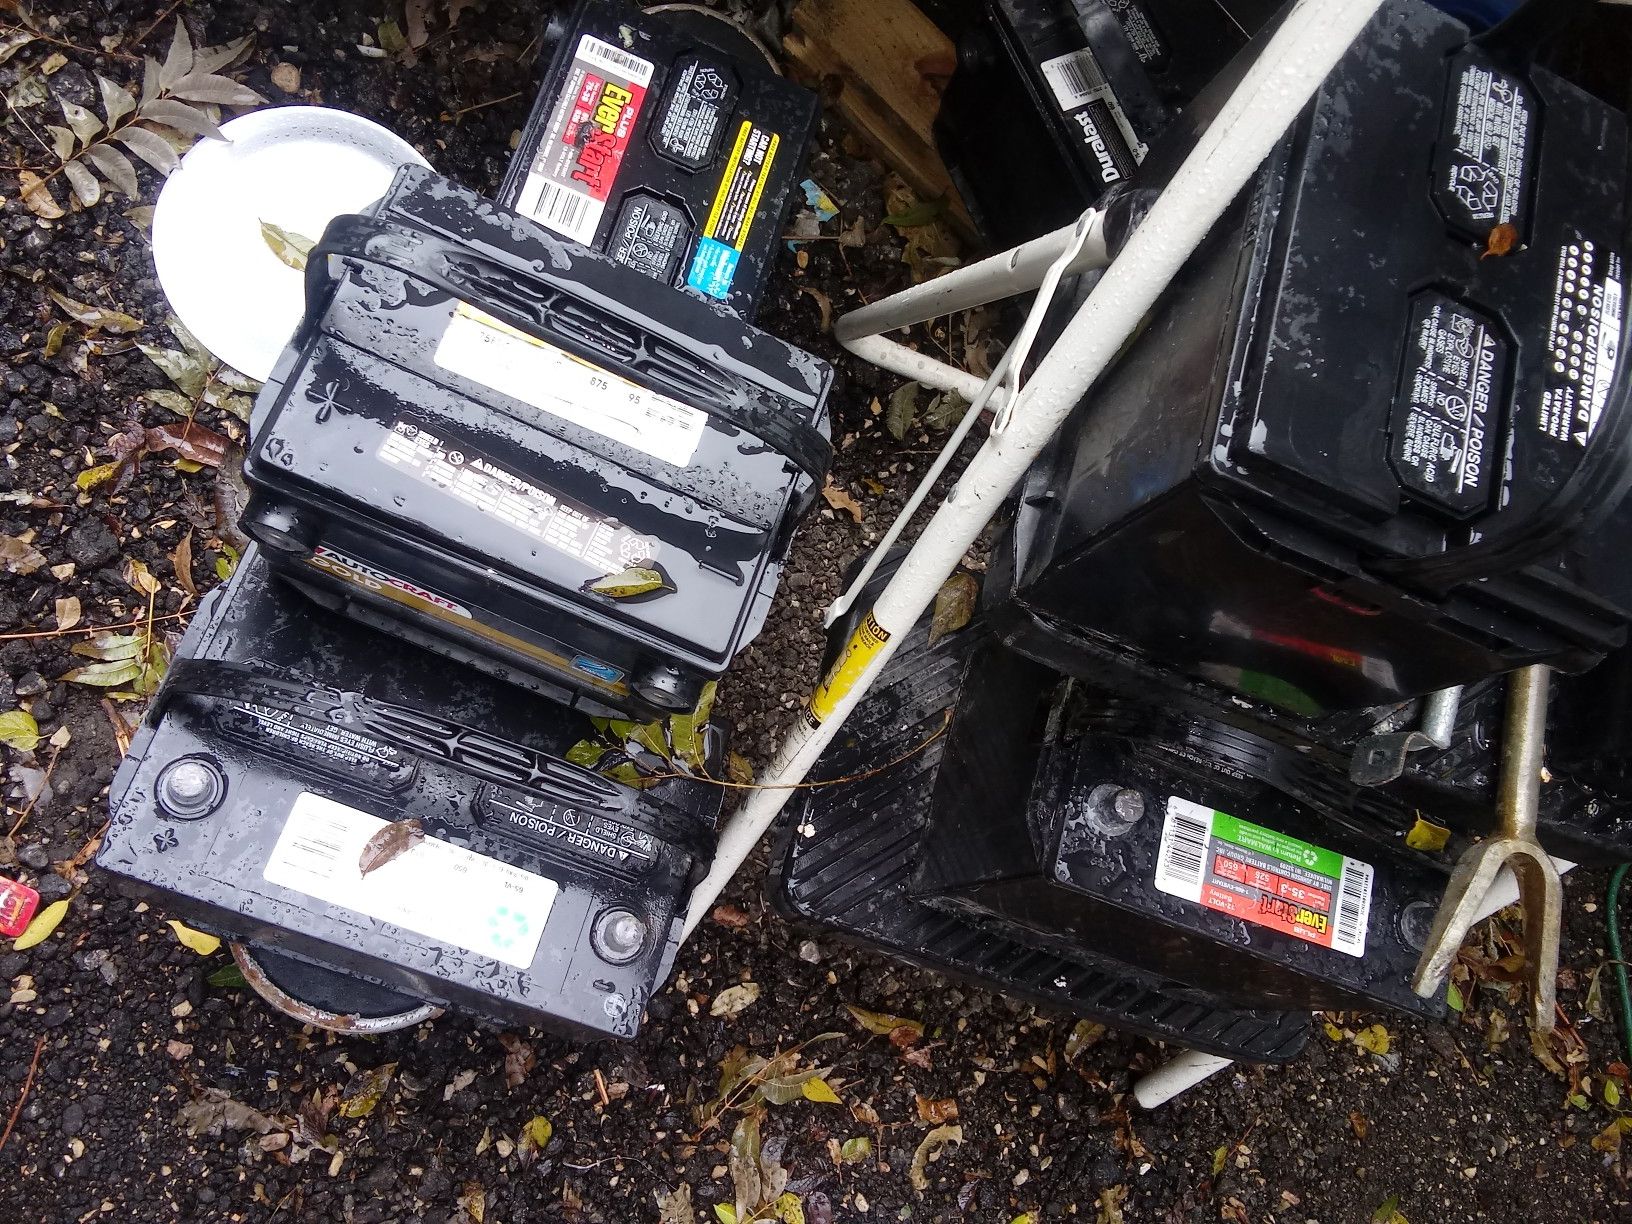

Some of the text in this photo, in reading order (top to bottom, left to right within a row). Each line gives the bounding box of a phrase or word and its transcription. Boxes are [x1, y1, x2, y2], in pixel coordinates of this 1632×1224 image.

[615, 106, 634, 139] PLUS
[739, 127, 763, 166] STARTING?
[752, 134, 770, 165] CAR NOT
[1074, 111, 1120, 183] Duralast
[624, 206, 642, 239] POISON
[1434, 328, 1447, 354] GASES
[1441, 332, 1456, 374] EXPLOSIVE
[1578, 284, 1604, 422] DANGER/POISON
[1450, 355, 1460, 376] EYES
[1457, 359, 1469, 386] SHIELD
[1475, 349, 1496, 412] DANGER
[589, 375, 609, 391] 875
[626, 392, 641, 405] 95
[1436, 391, 1446, 405] NO
[1538, 391, 1553, 431] LIMITED
[1548, 387, 1564, 436] PRO-RATA
[1558, 386, 1576, 441] WARRANTY
[1402, 411, 1417, 461] SEVERE BURNS
[1410, 415, 1425, 466] BLINDNESS OR
[1419, 419, 1432, 458] CAN CAUSE
[1424, 422, 1441, 482] SULFURIC ACID
[1463, 427, 1485, 487] POISON
[481, 462, 557, 506] DANGER/POISON
[310, 556, 383, 589] GOLD
[324, 553, 457, 609] AUTOCRAFT
[868, 616, 888, 640] TION
[273, 724, 285, 732] AND
[299, 721, 375, 753] FLUSH EYES IMMEDIATELY
[325, 724, 338, 733] GET
[360, 736, 377, 747] WITH
[1220, 766, 1231, 774] OUT
[508, 810, 556, 836] POISON
[594, 825, 617, 839] SHIELD
[602, 821, 619, 832] EYES
[565, 831, 617, 857] DANGER
[1237, 835, 1272, 851] WALMART
[1222, 860, 1239, 871] 650
[1207, 896, 1235, 910] 12-VOLT
[1208, 888, 1233, 902] Battery
[1279, 882, 1306, 899] 35-3
[1258, 893, 1327, 935] EverStart
